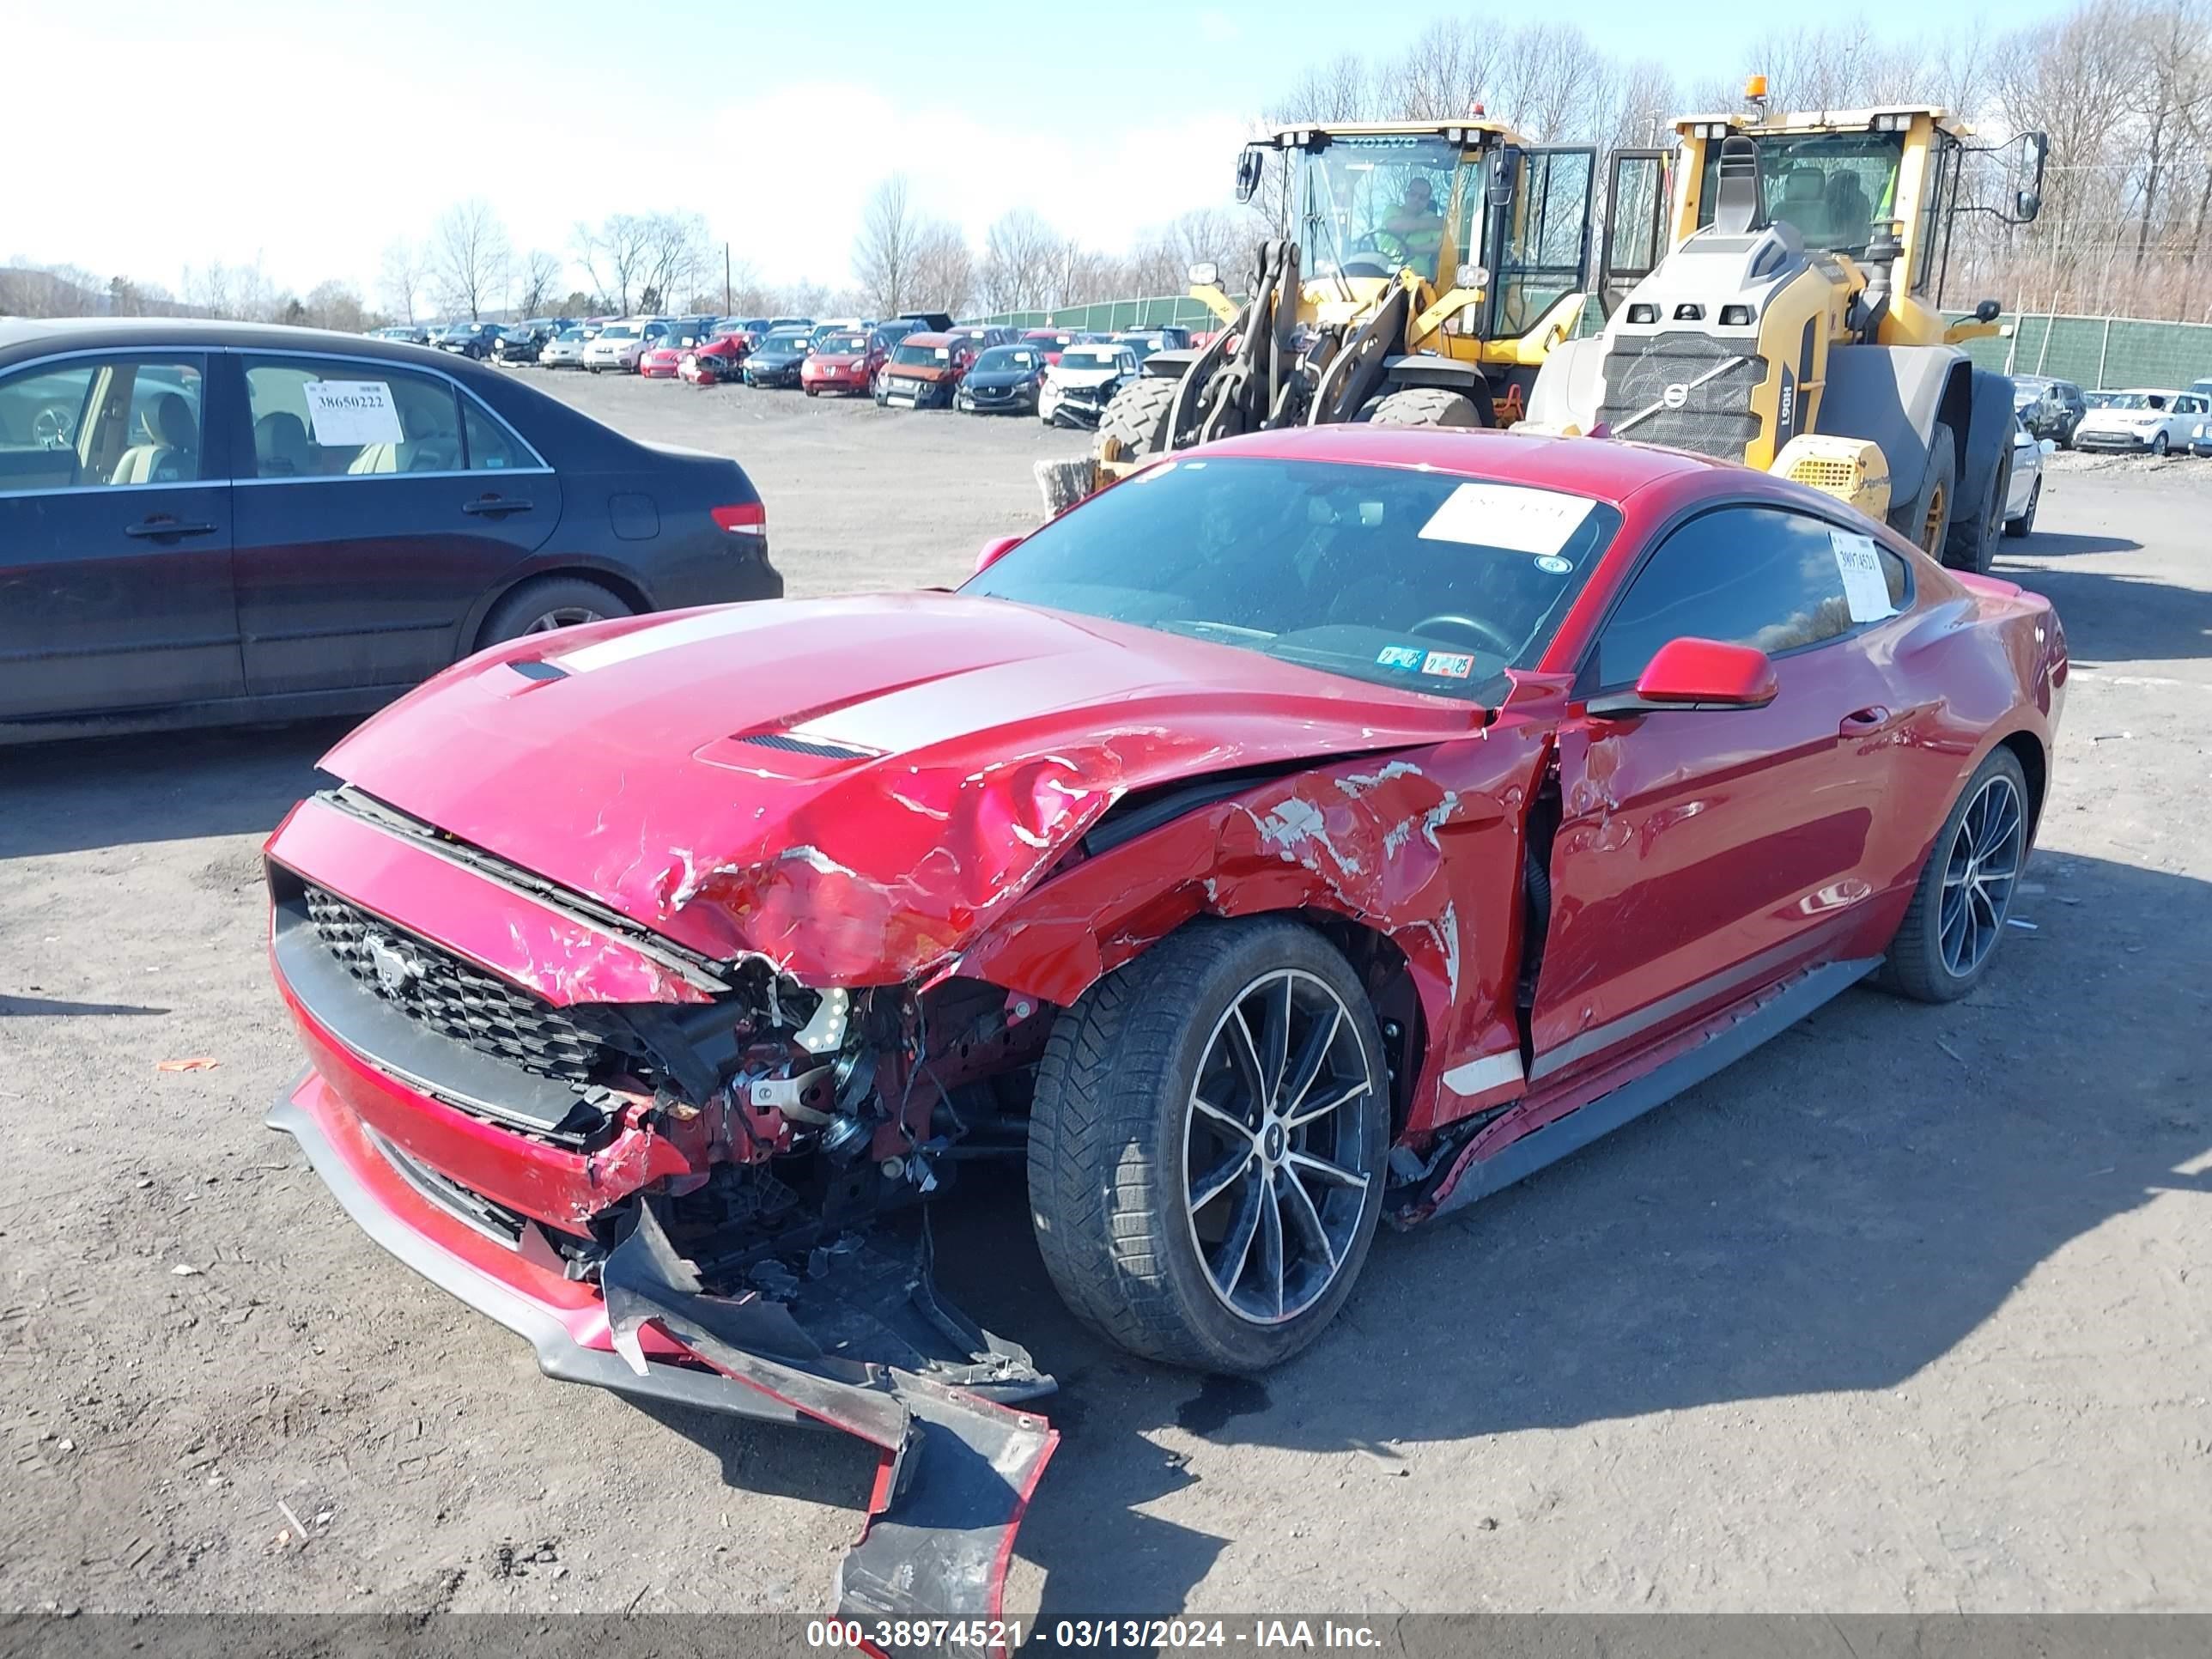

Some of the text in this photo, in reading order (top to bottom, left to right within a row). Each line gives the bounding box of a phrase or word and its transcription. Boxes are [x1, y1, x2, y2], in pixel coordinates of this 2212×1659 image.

[1346, 137, 1419, 149] VOLVO
[319, 396, 385, 409] 38650222
[1781, 386, 1792, 426] L90H
[1381, 650, 1392, 662] 2
[1428, 659, 1469, 674] 2 25
